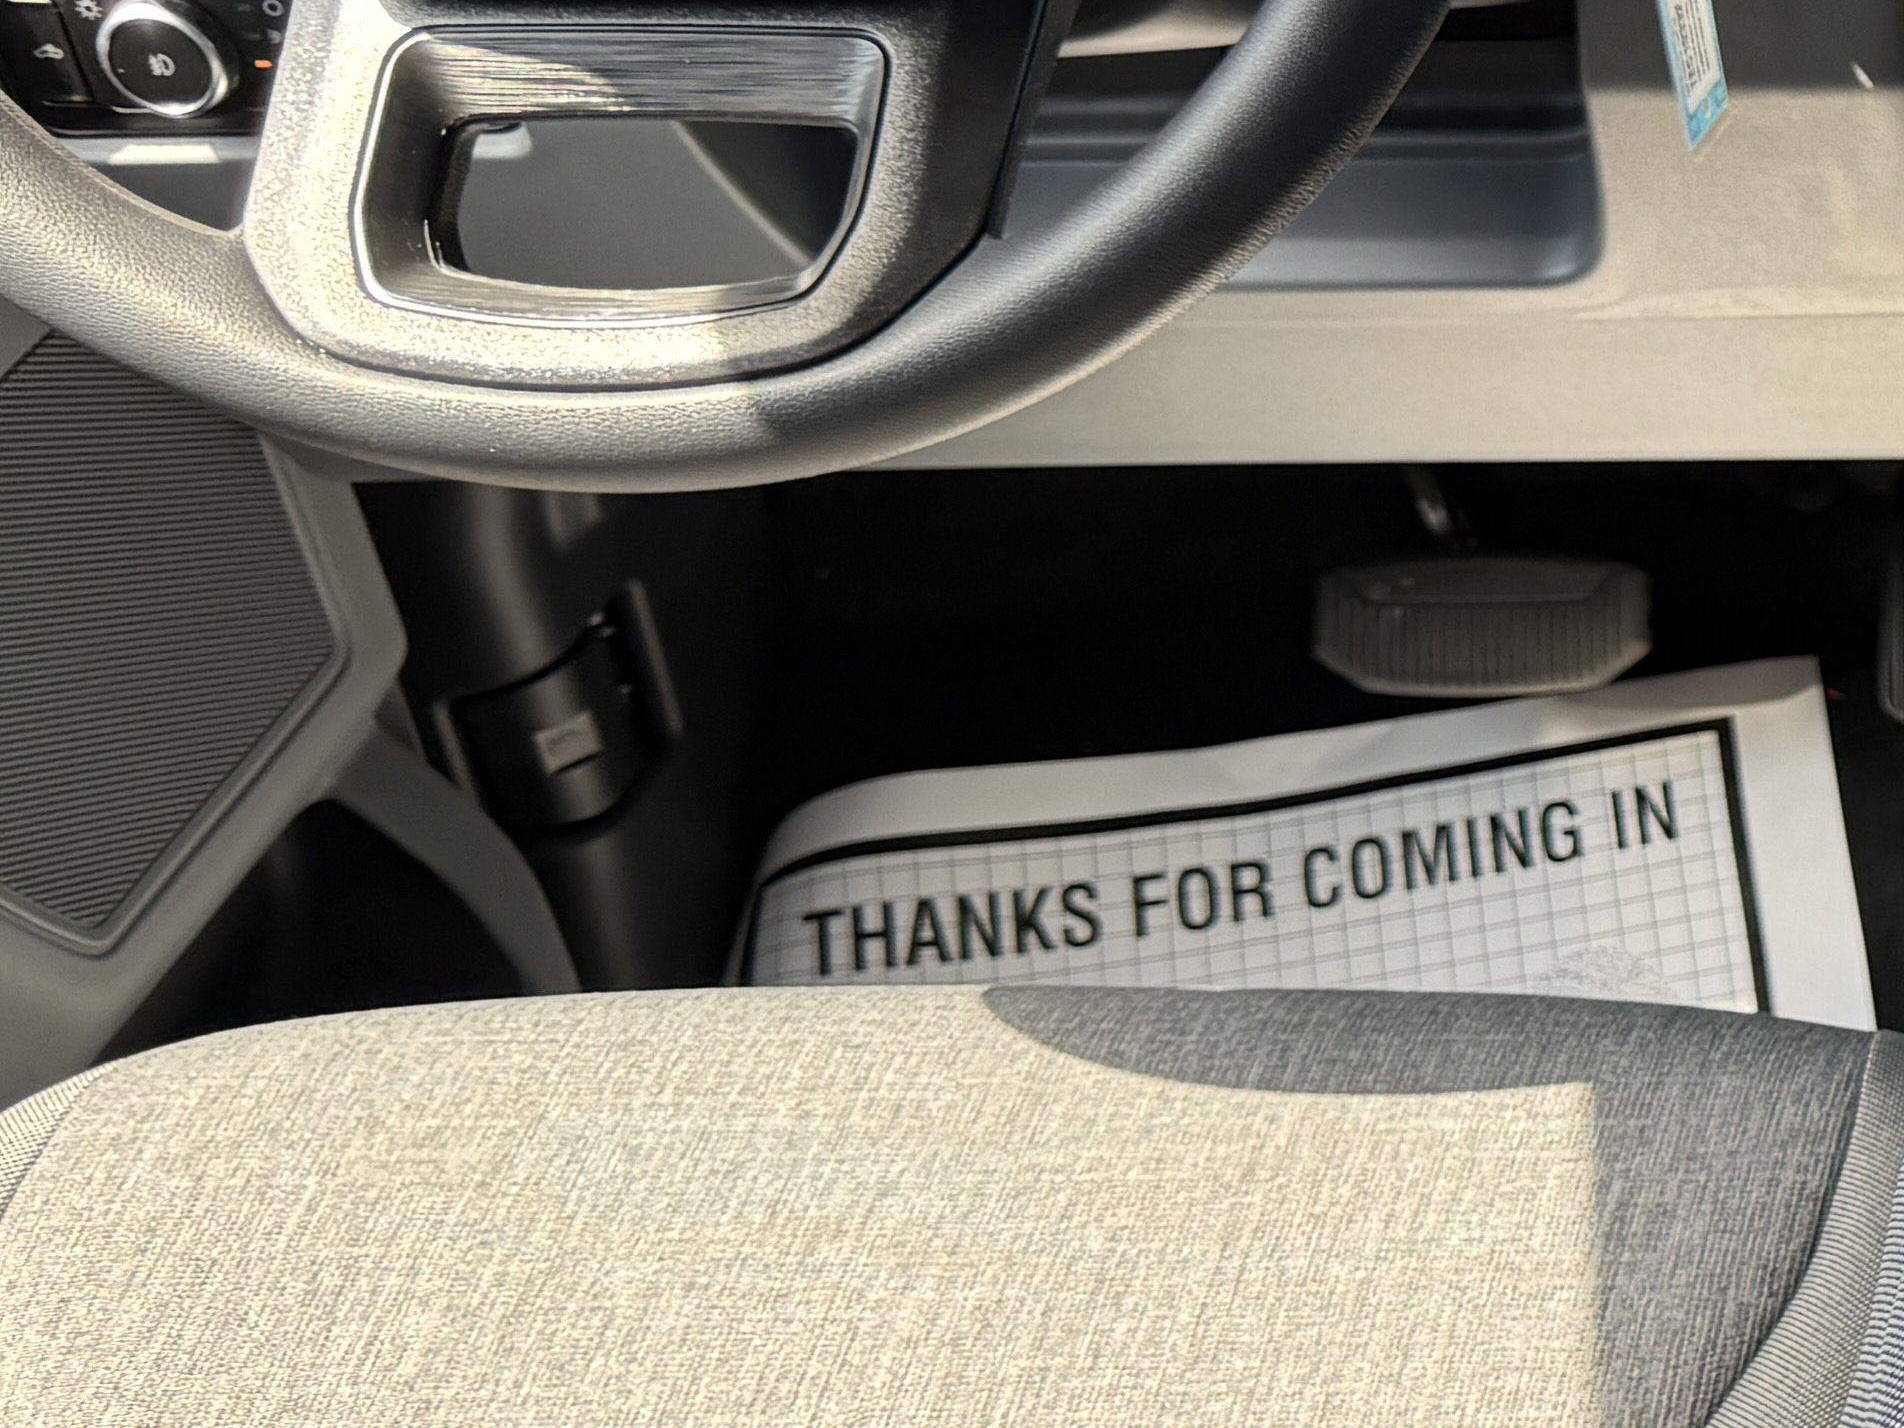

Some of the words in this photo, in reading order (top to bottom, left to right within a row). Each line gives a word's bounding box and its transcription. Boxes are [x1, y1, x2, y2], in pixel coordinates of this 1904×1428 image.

[802, 880, 1104, 979] THANKS
[1131, 856, 1275, 938] FOR
[1300, 796, 1585, 912] COMING
[1608, 779, 1681, 853] IN
